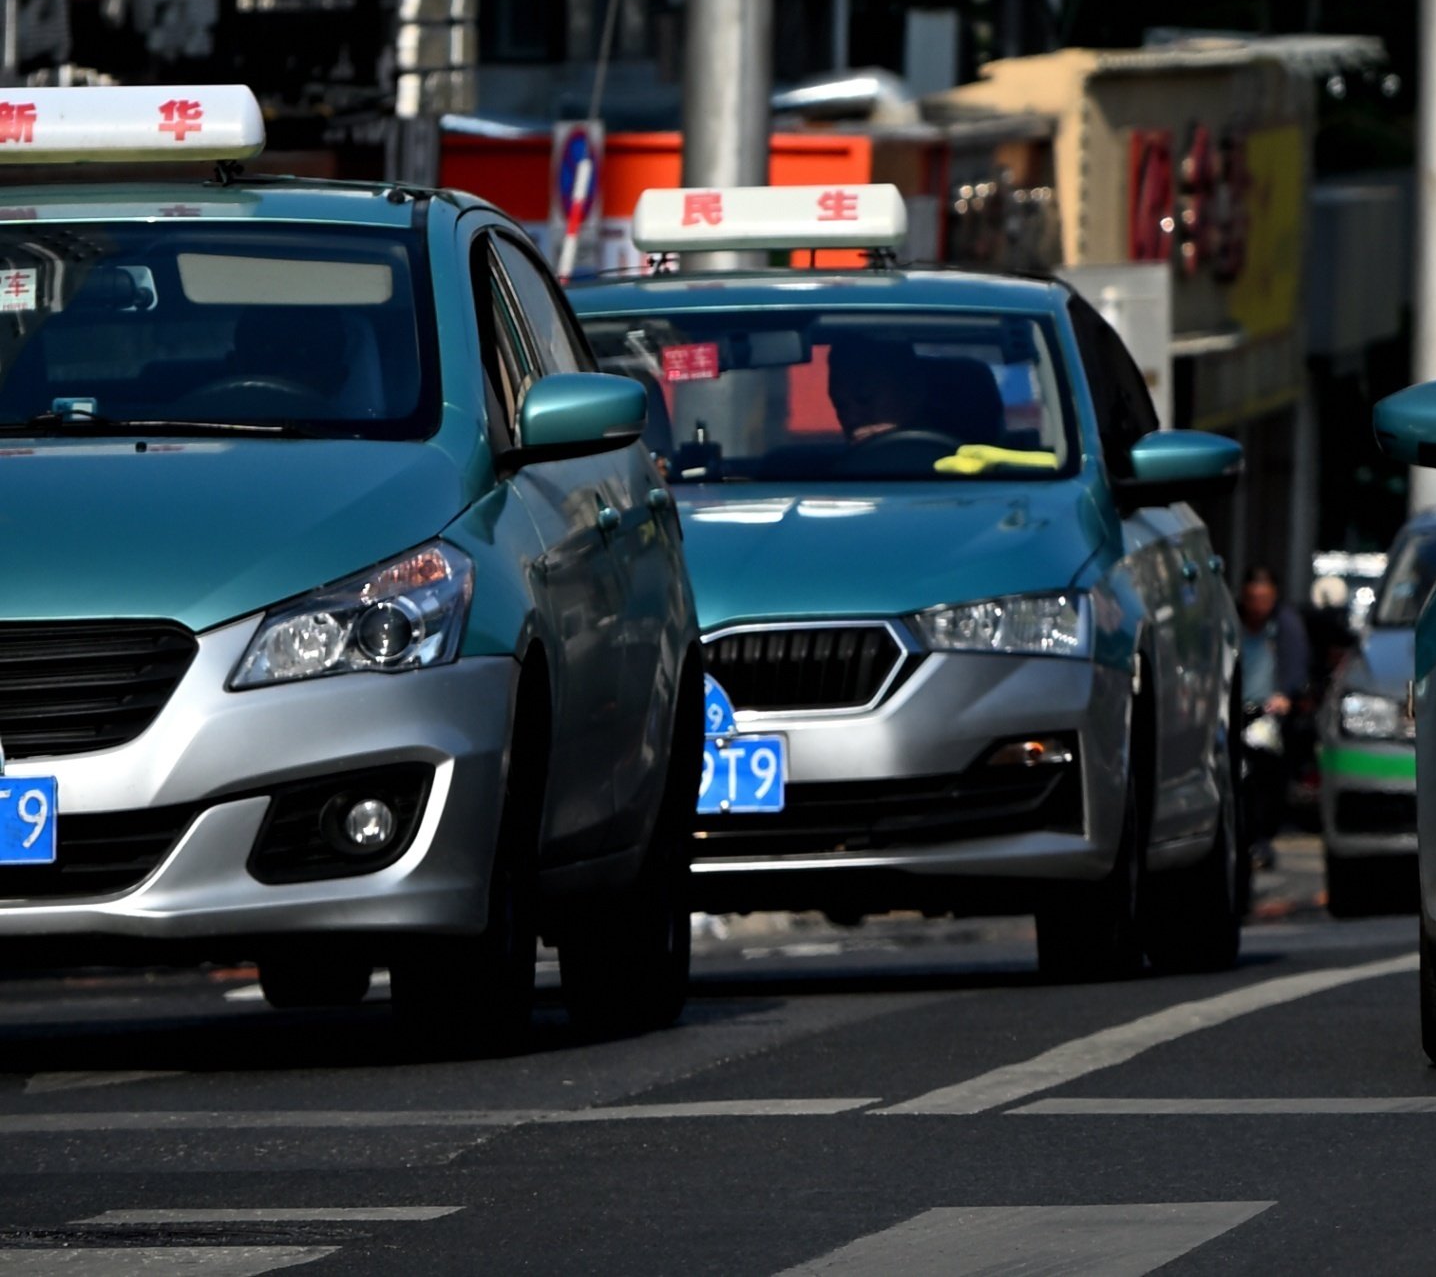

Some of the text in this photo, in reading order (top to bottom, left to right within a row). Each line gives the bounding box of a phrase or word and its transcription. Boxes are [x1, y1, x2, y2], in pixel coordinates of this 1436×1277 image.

[681, 189, 859, 226] 民生
[0, 271, 31, 297] 车
[0, 788, 48, 849] 9
